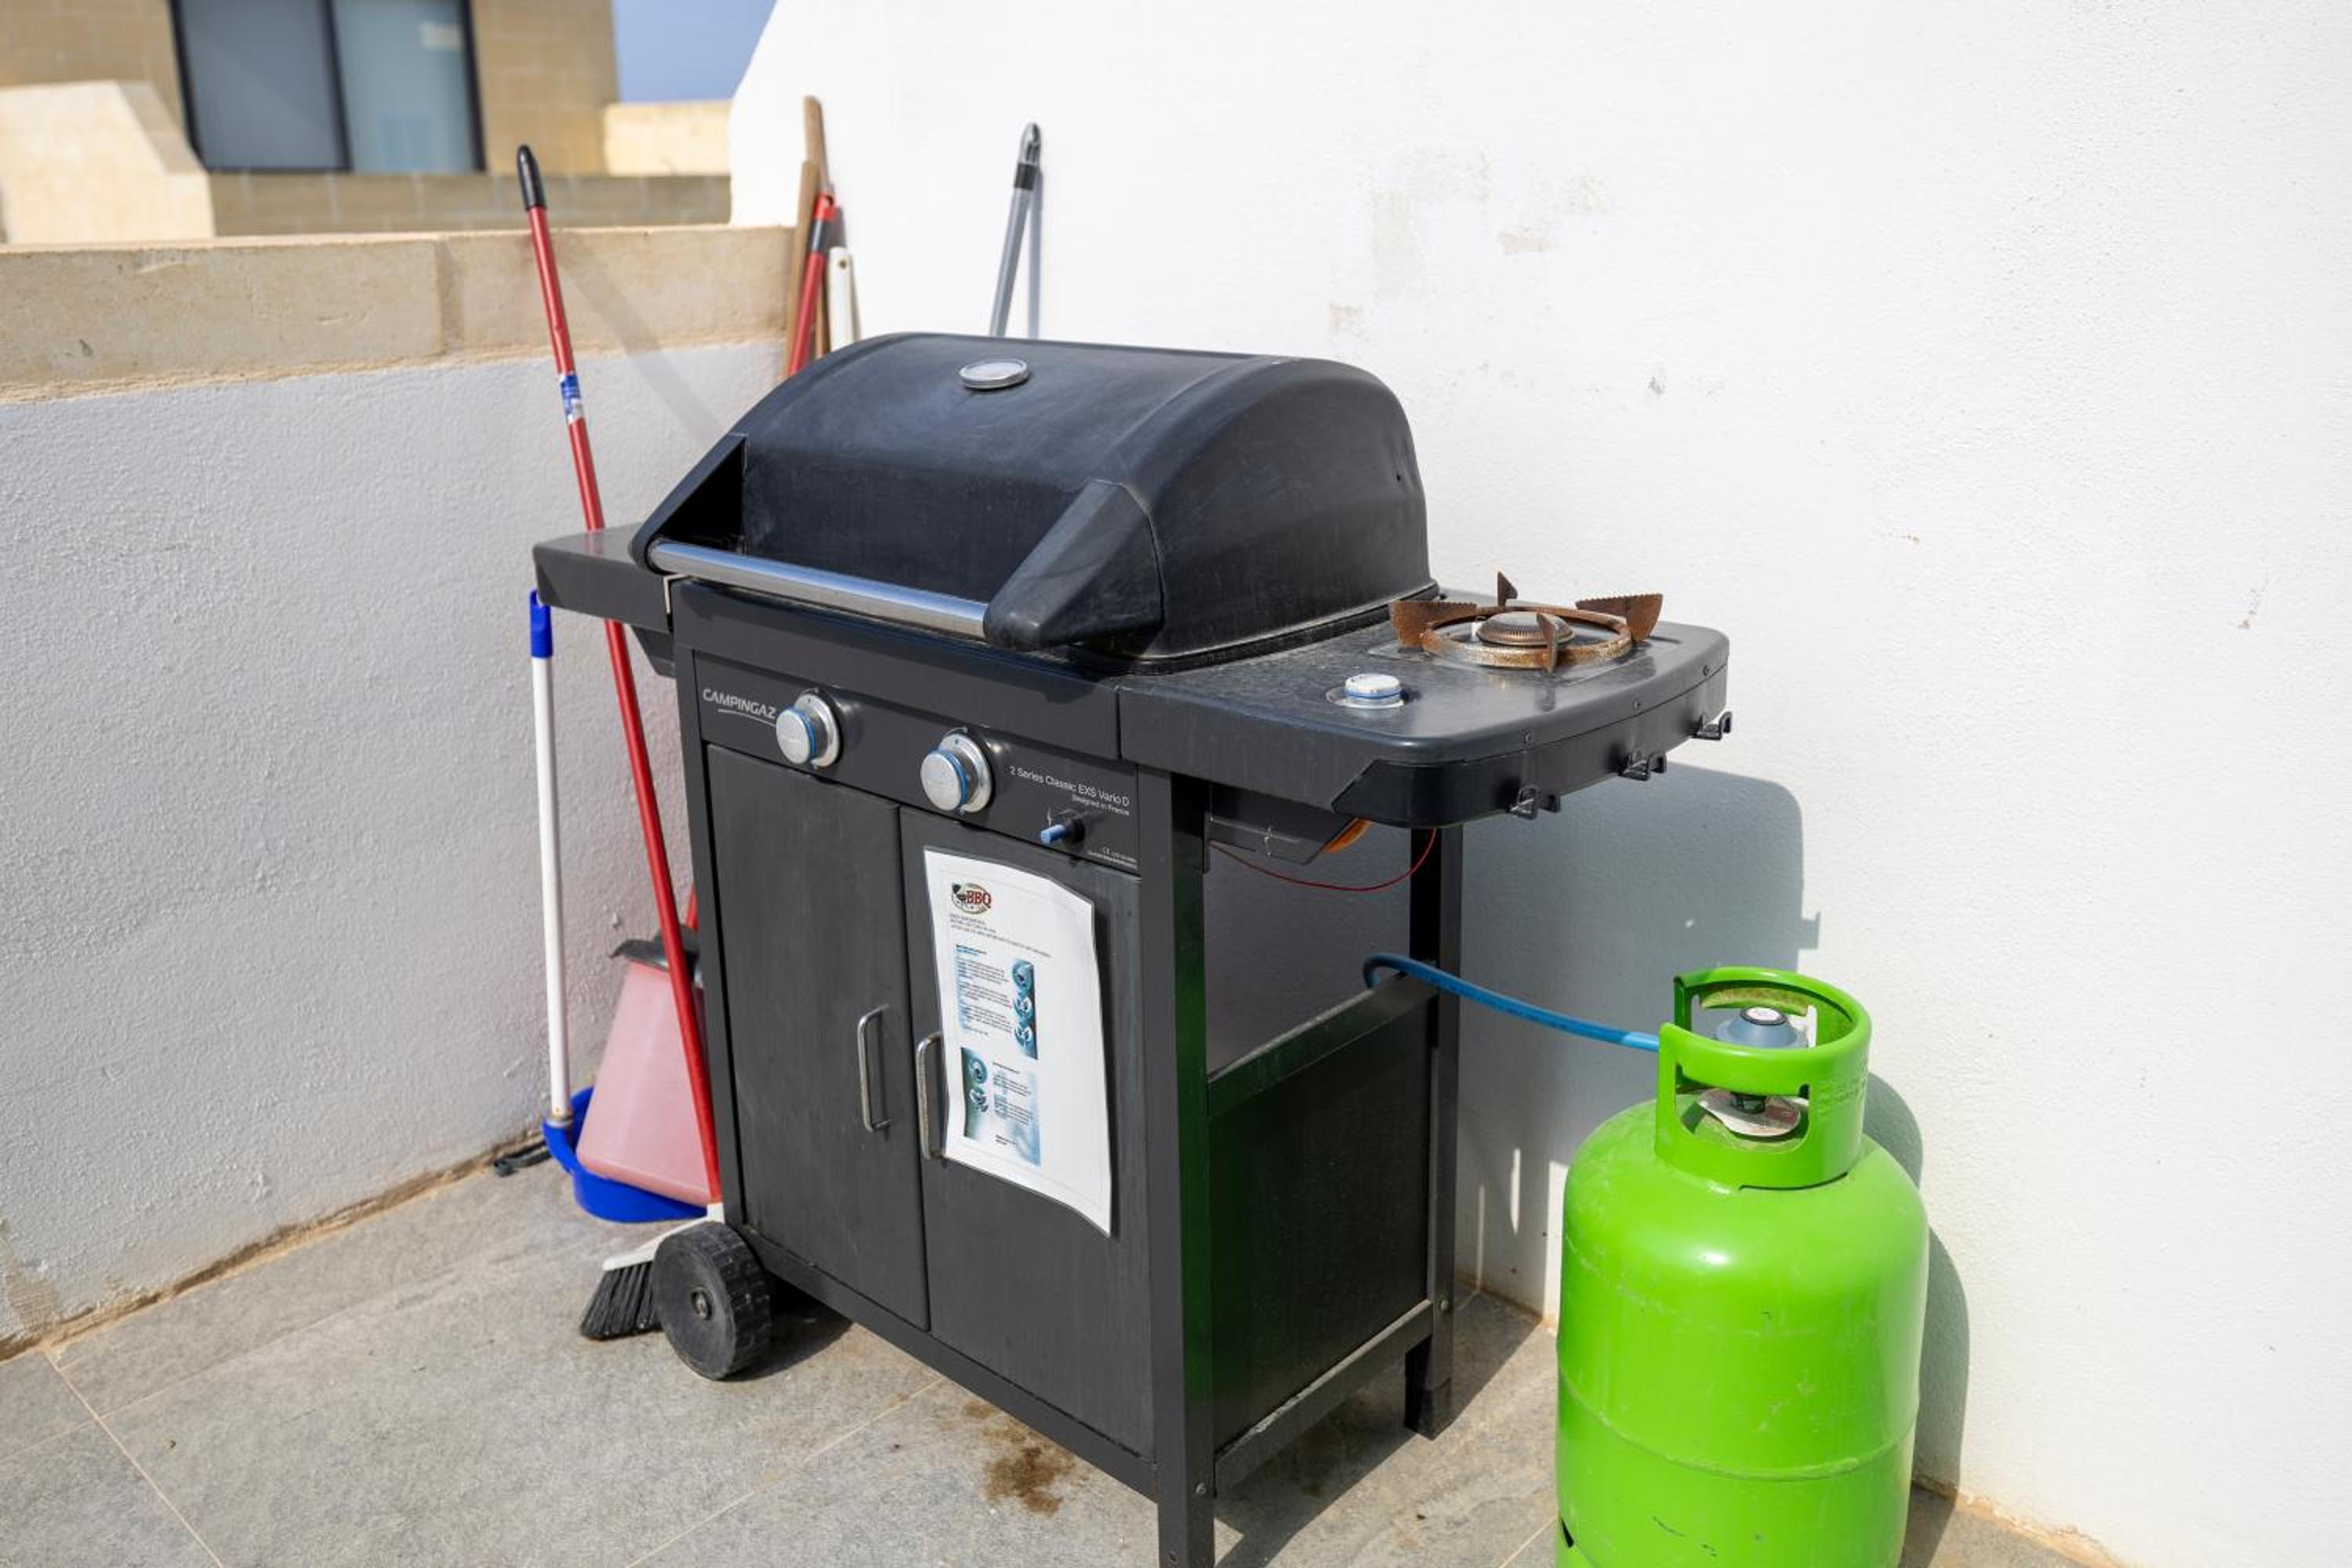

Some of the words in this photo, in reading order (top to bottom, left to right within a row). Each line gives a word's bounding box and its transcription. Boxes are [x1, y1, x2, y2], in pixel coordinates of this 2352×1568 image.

[702, 688, 777, 719] CAMPINGAZ
[1010, 765, 1015, 775] 2
[1017, 768, 1044, 783] Series
[1045, 775, 1076, 792] Classic
[1078, 783, 1097, 797] EXS
[1098, 790, 1121, 804] Vario
[1122, 797, 1129, 806] D
[967, 891, 991, 908] BBQ
